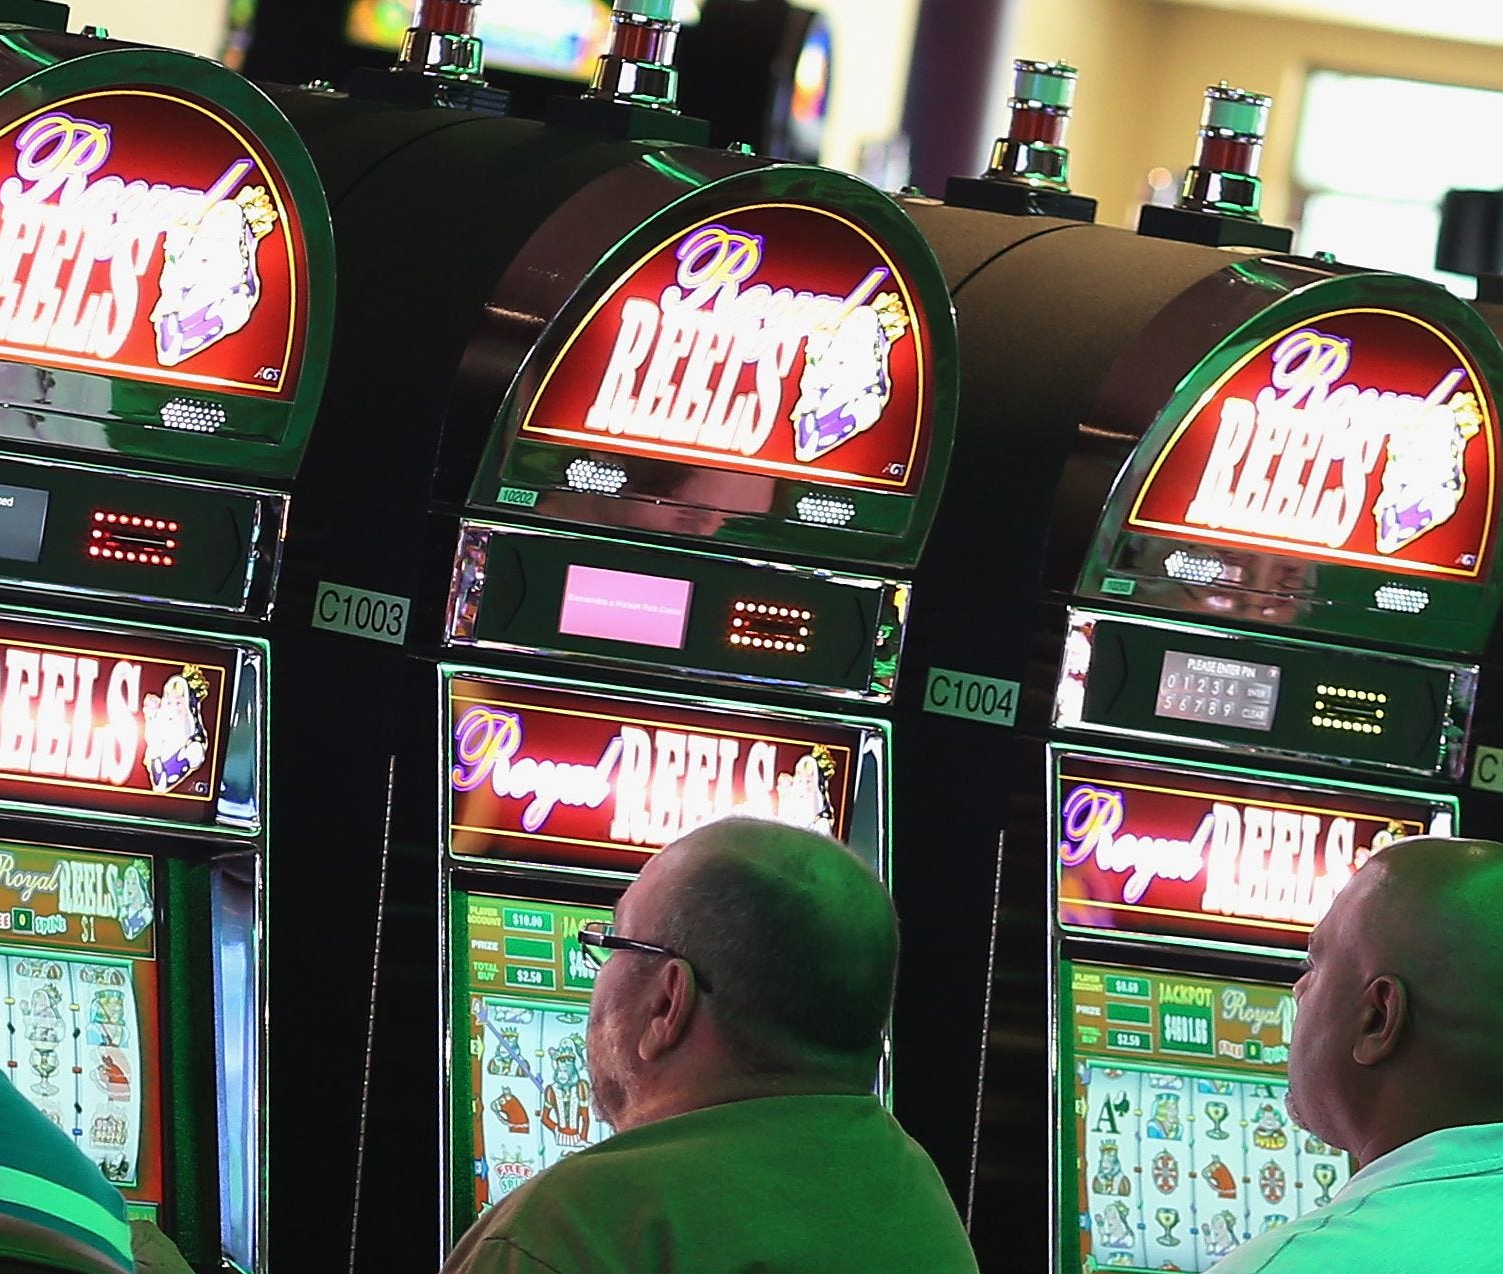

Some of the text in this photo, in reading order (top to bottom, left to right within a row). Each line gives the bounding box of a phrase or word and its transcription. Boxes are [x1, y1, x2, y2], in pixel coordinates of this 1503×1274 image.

[0, 111, 253, 261] Royal
[661, 225, 888, 363] Royal
[253, 367, 281, 381] AGS
[585, 296, 799, 456] REELS
[1185, 397, 1391, 548] REELS
[503, 489, 534, 504] 10202
[319, 590, 404, 636] C1003
[1167, 674, 1176, 688] 0
[1196, 678, 1205, 693] 2
[1211, 680, 1219, 695] 3
[1226, 683, 1235, 696] 4
[1187, 658, 1257, 678] PLEASE ENTER PIN
[930, 676, 1013, 717] C1004
[1163, 695, 1173, 710] 5
[1179, 697, 1187, 712] 6
[1193, 699, 1202, 713] 7
[1208, 701, 1217, 716] 8
[1223, 703, 1232, 717] 9
[452, 705, 624, 833] Royal
[1060, 784, 1216, 905] Royal
[59, 860, 119, 918] REELS
[1159, 982, 1213, 1007] JACKPOT
[1222, 987, 1282, 1034] Royal
[496, 1163, 534, 1178] FREE
